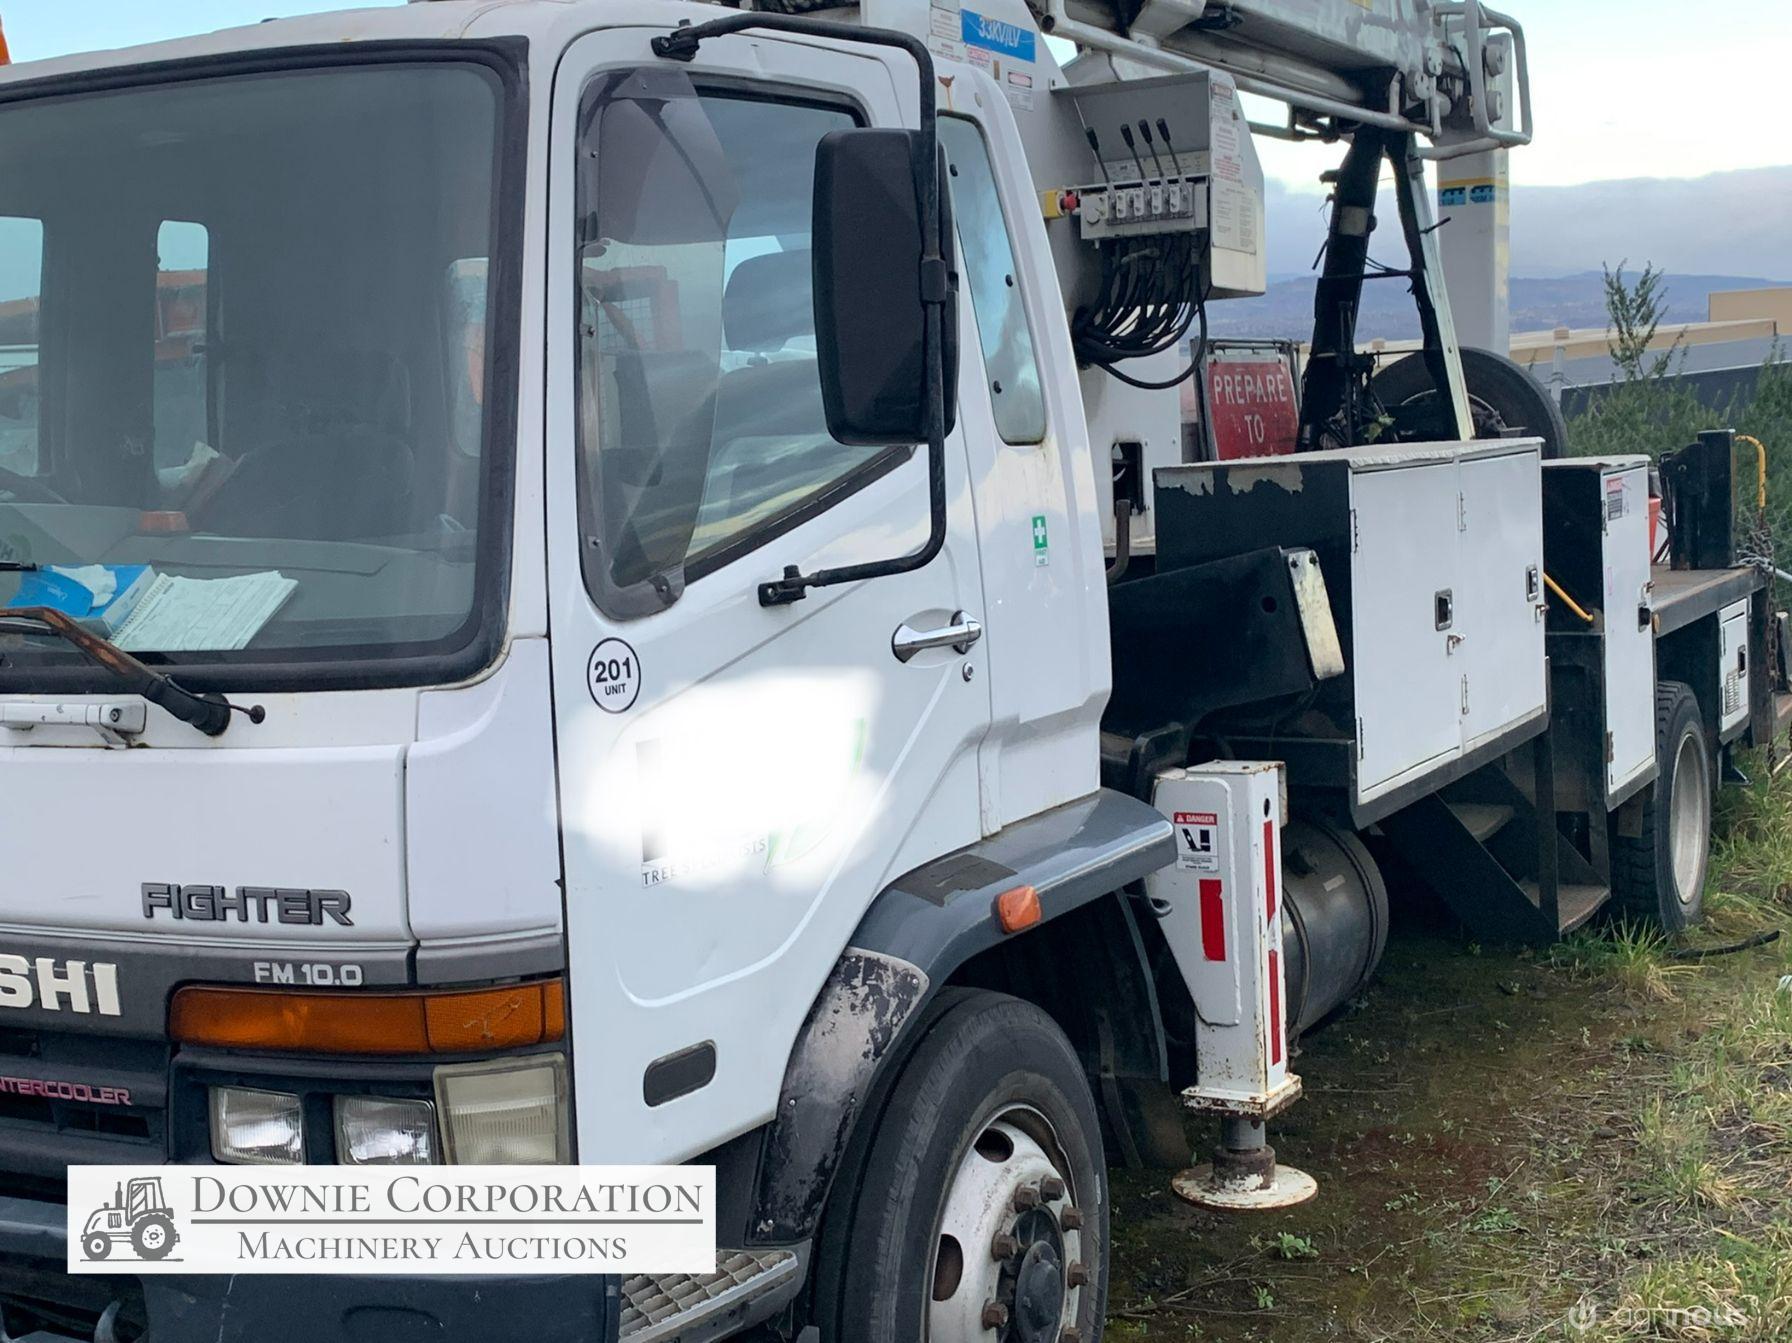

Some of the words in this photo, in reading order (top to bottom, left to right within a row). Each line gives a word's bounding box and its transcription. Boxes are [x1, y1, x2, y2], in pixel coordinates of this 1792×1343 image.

[1213, 374, 1288, 405] PREPARE
[1244, 414, 1265, 444] TO
[594, 656, 632, 683] 201
[604, 683, 627, 696] UNIT
[1186, 814, 1215, 824] DANGER
[641, 864, 677, 886] TREE
[141, 882, 354, 926] FIGHTER
[254, 962, 294, 985] FM
[301, 964, 364, 987] 10.0
